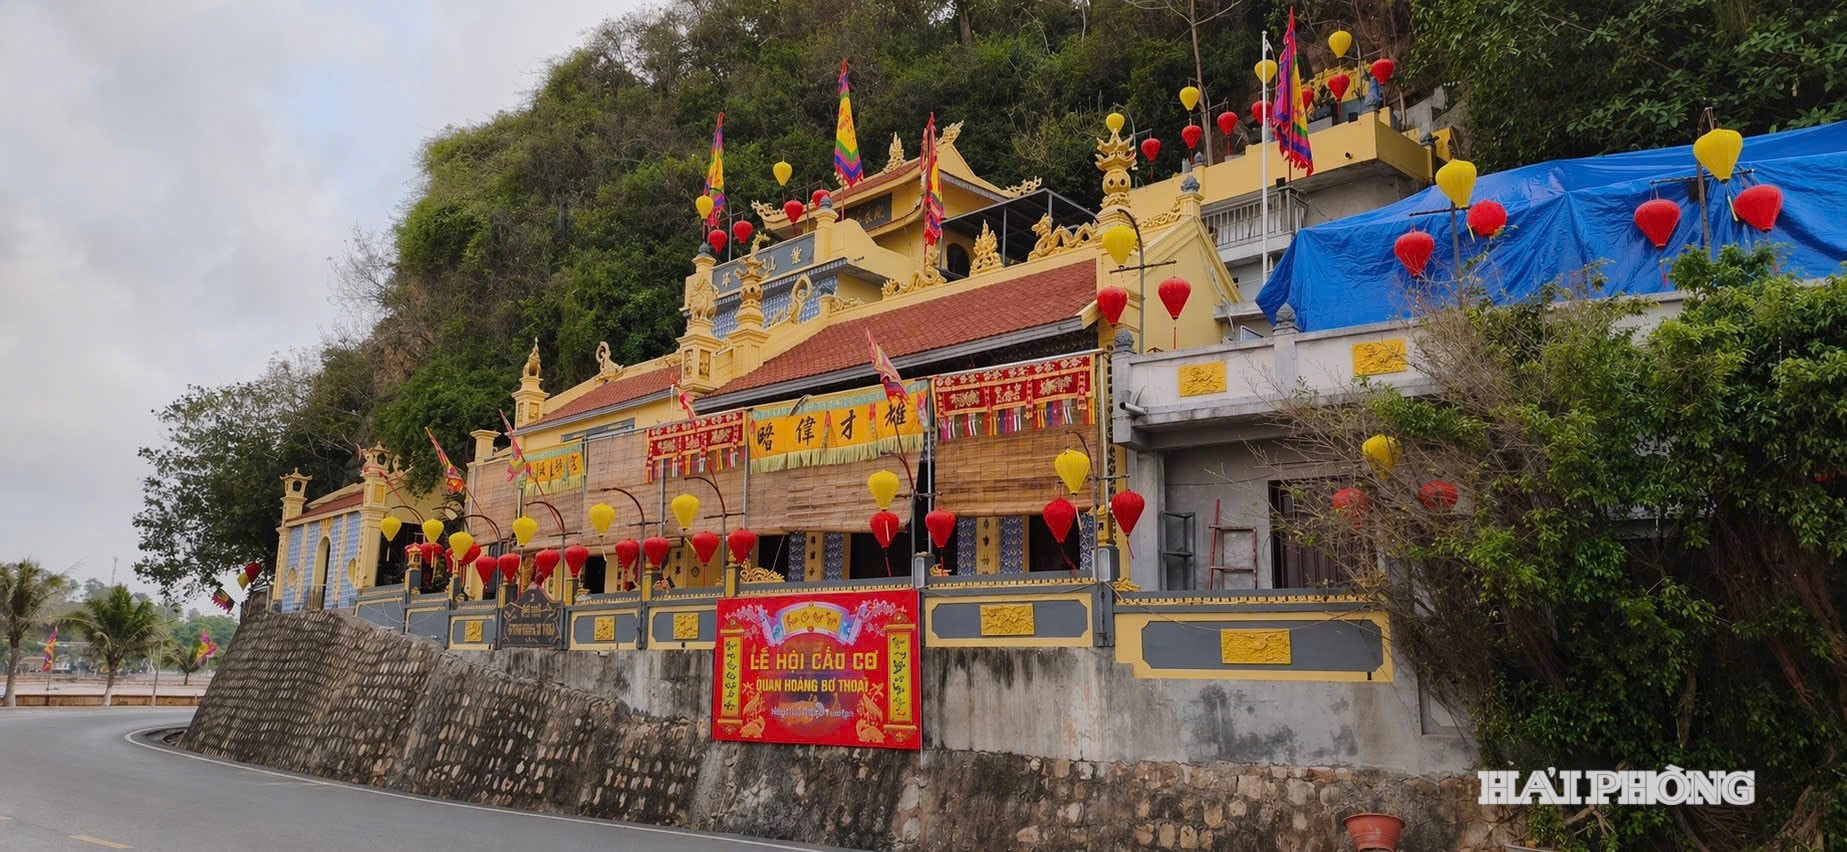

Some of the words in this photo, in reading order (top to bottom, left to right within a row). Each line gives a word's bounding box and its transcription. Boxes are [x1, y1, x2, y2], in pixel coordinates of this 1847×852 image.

[776, 649, 805, 674] HỘI
[852, 649, 879, 671] CƠ
[756, 678, 782, 693] QUAN
